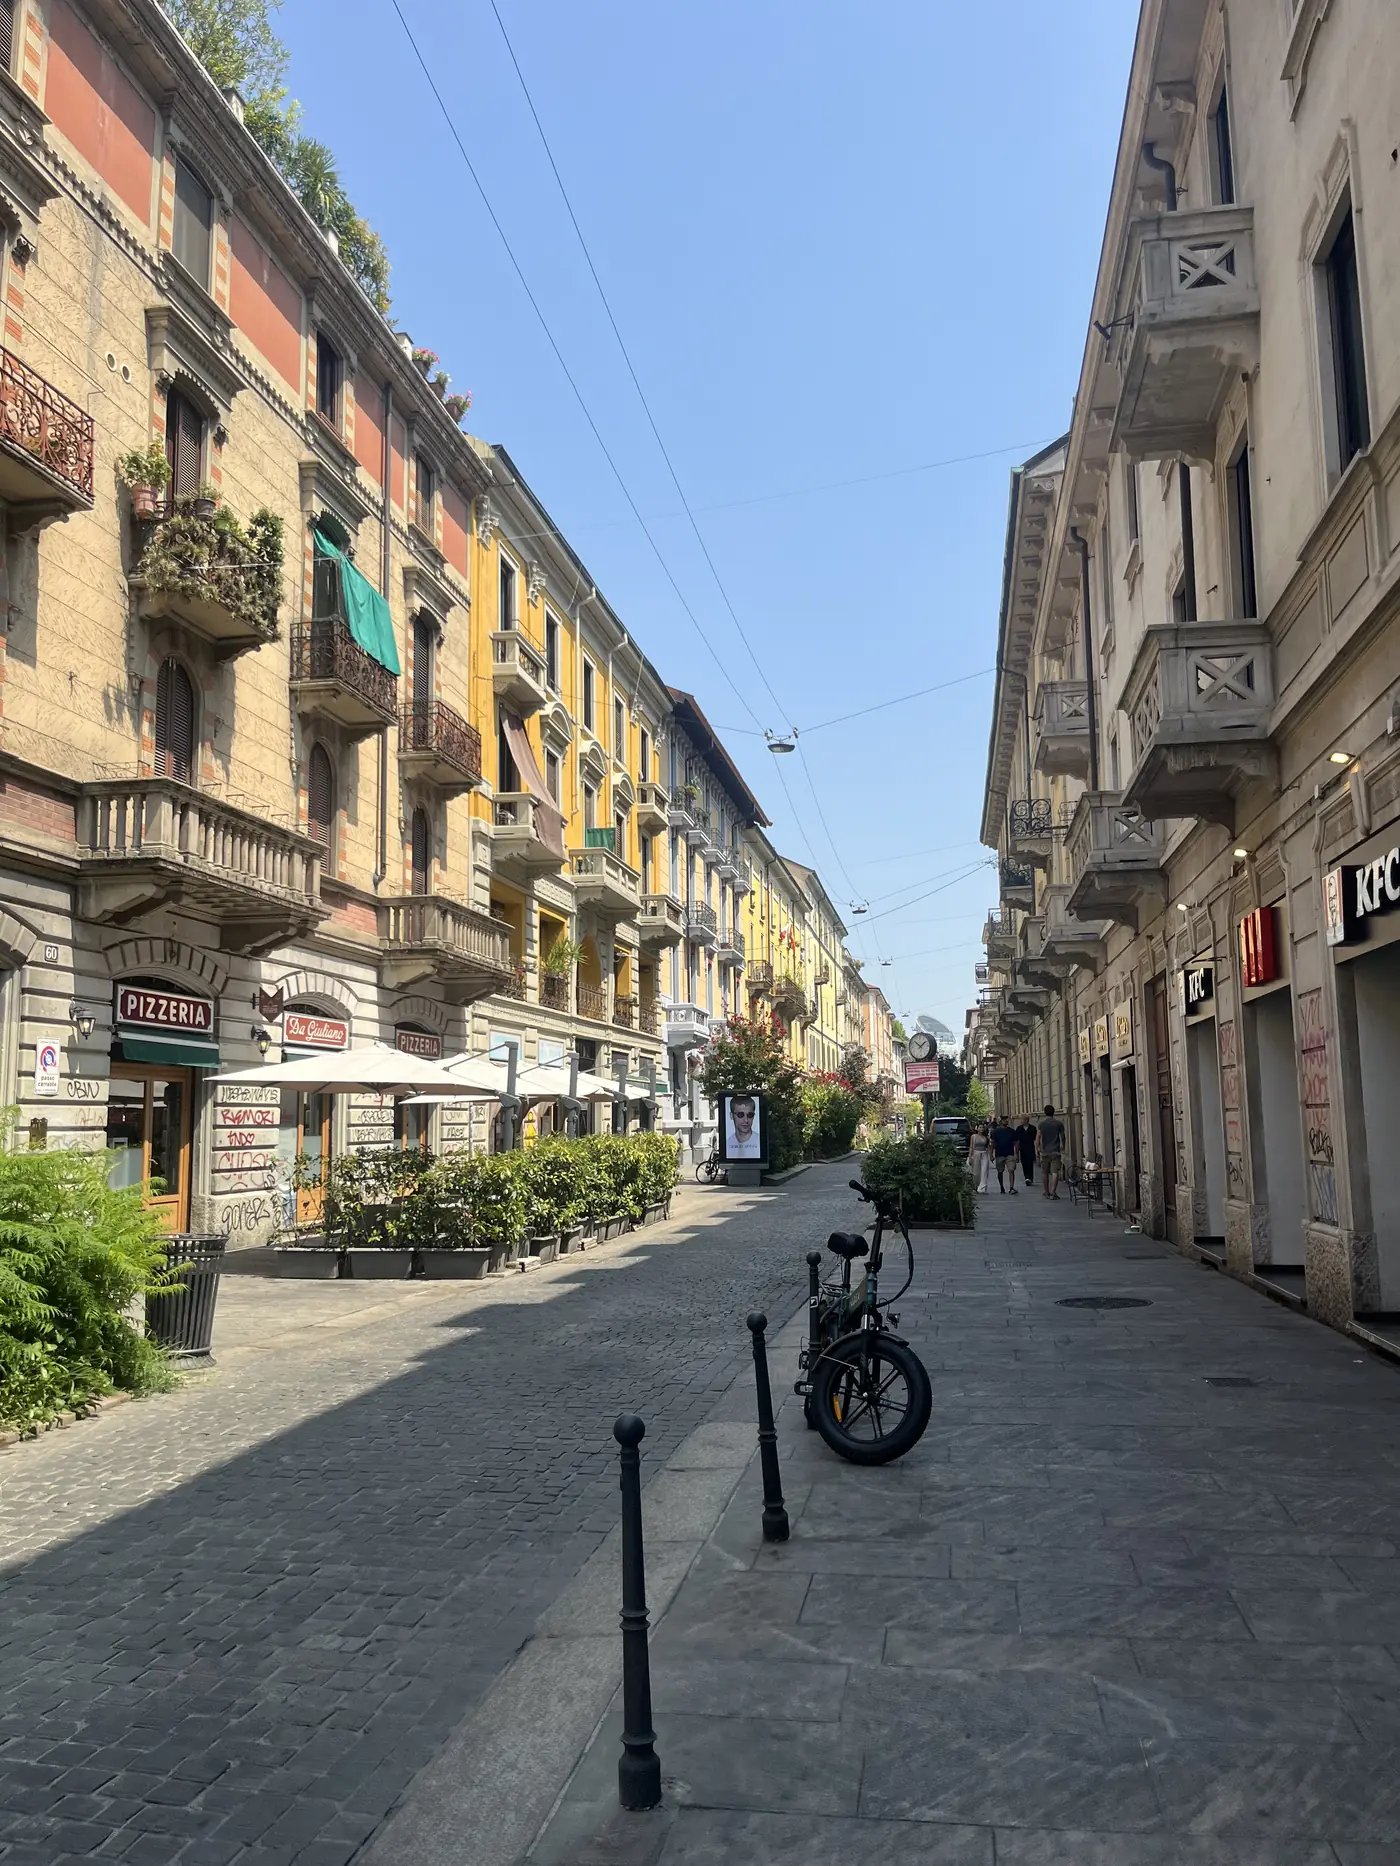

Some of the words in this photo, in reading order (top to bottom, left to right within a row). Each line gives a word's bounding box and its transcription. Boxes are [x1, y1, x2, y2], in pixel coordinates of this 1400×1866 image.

[1355, 847, 1400, 918] KFC
[45, 945, 57, 960] 60
[1188, 967, 1205, 1003] KFC
[127, 994, 205, 1026] PIZZERIA
[289, 1017, 305, 1036] Da
[305, 1020, 344, 1042] Giuliano
[400, 1035, 438, 1055] PIZZERIA
